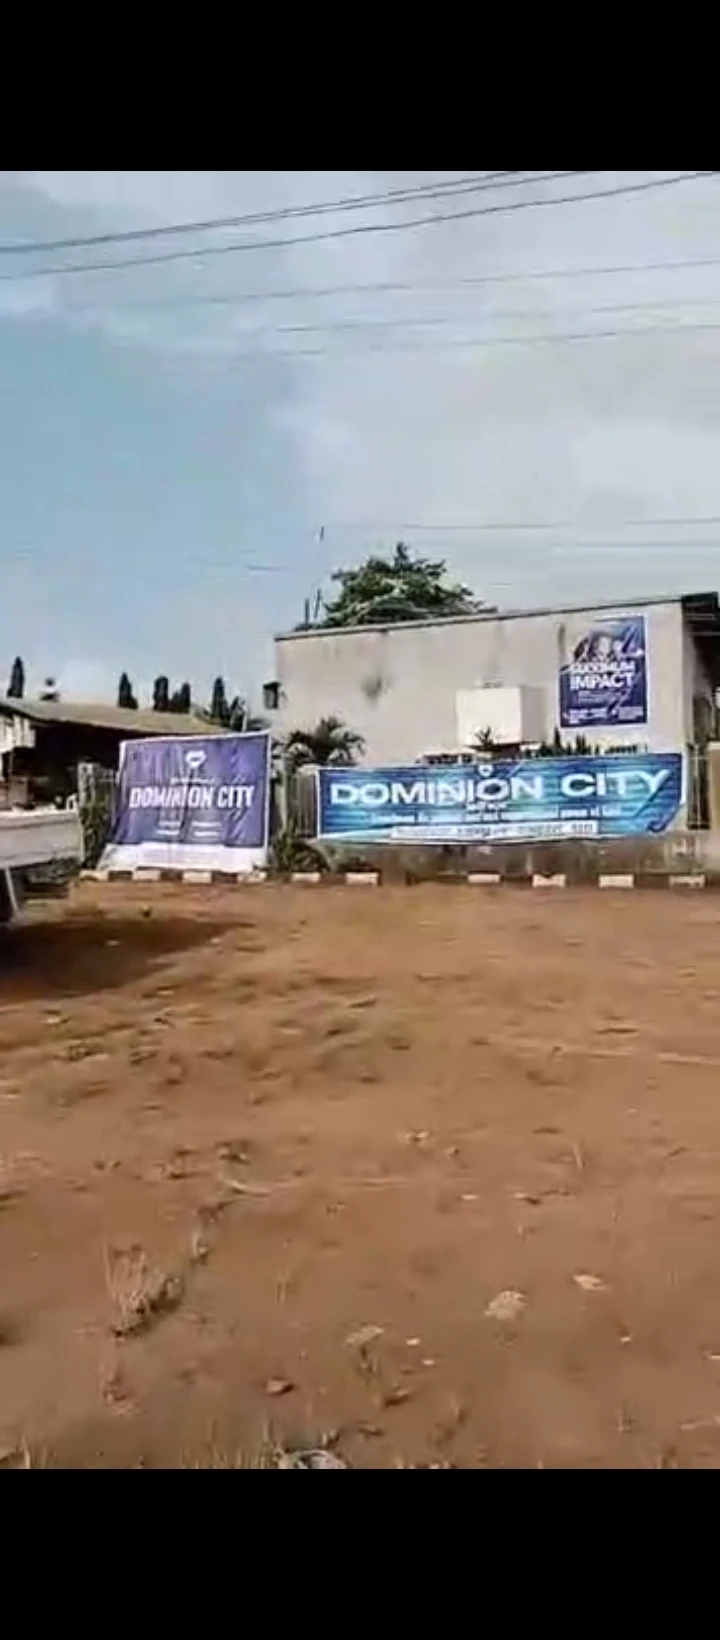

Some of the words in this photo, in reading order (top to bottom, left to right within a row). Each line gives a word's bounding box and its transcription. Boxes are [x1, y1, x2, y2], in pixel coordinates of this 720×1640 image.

[570, 672, 635, 691] IMPACT
[129, 786, 214, 808] DOMINION
[217, 786, 255, 808] CITY
[330, 777, 543, 807] DOMINION
[560, 769, 671, 800] CITY
